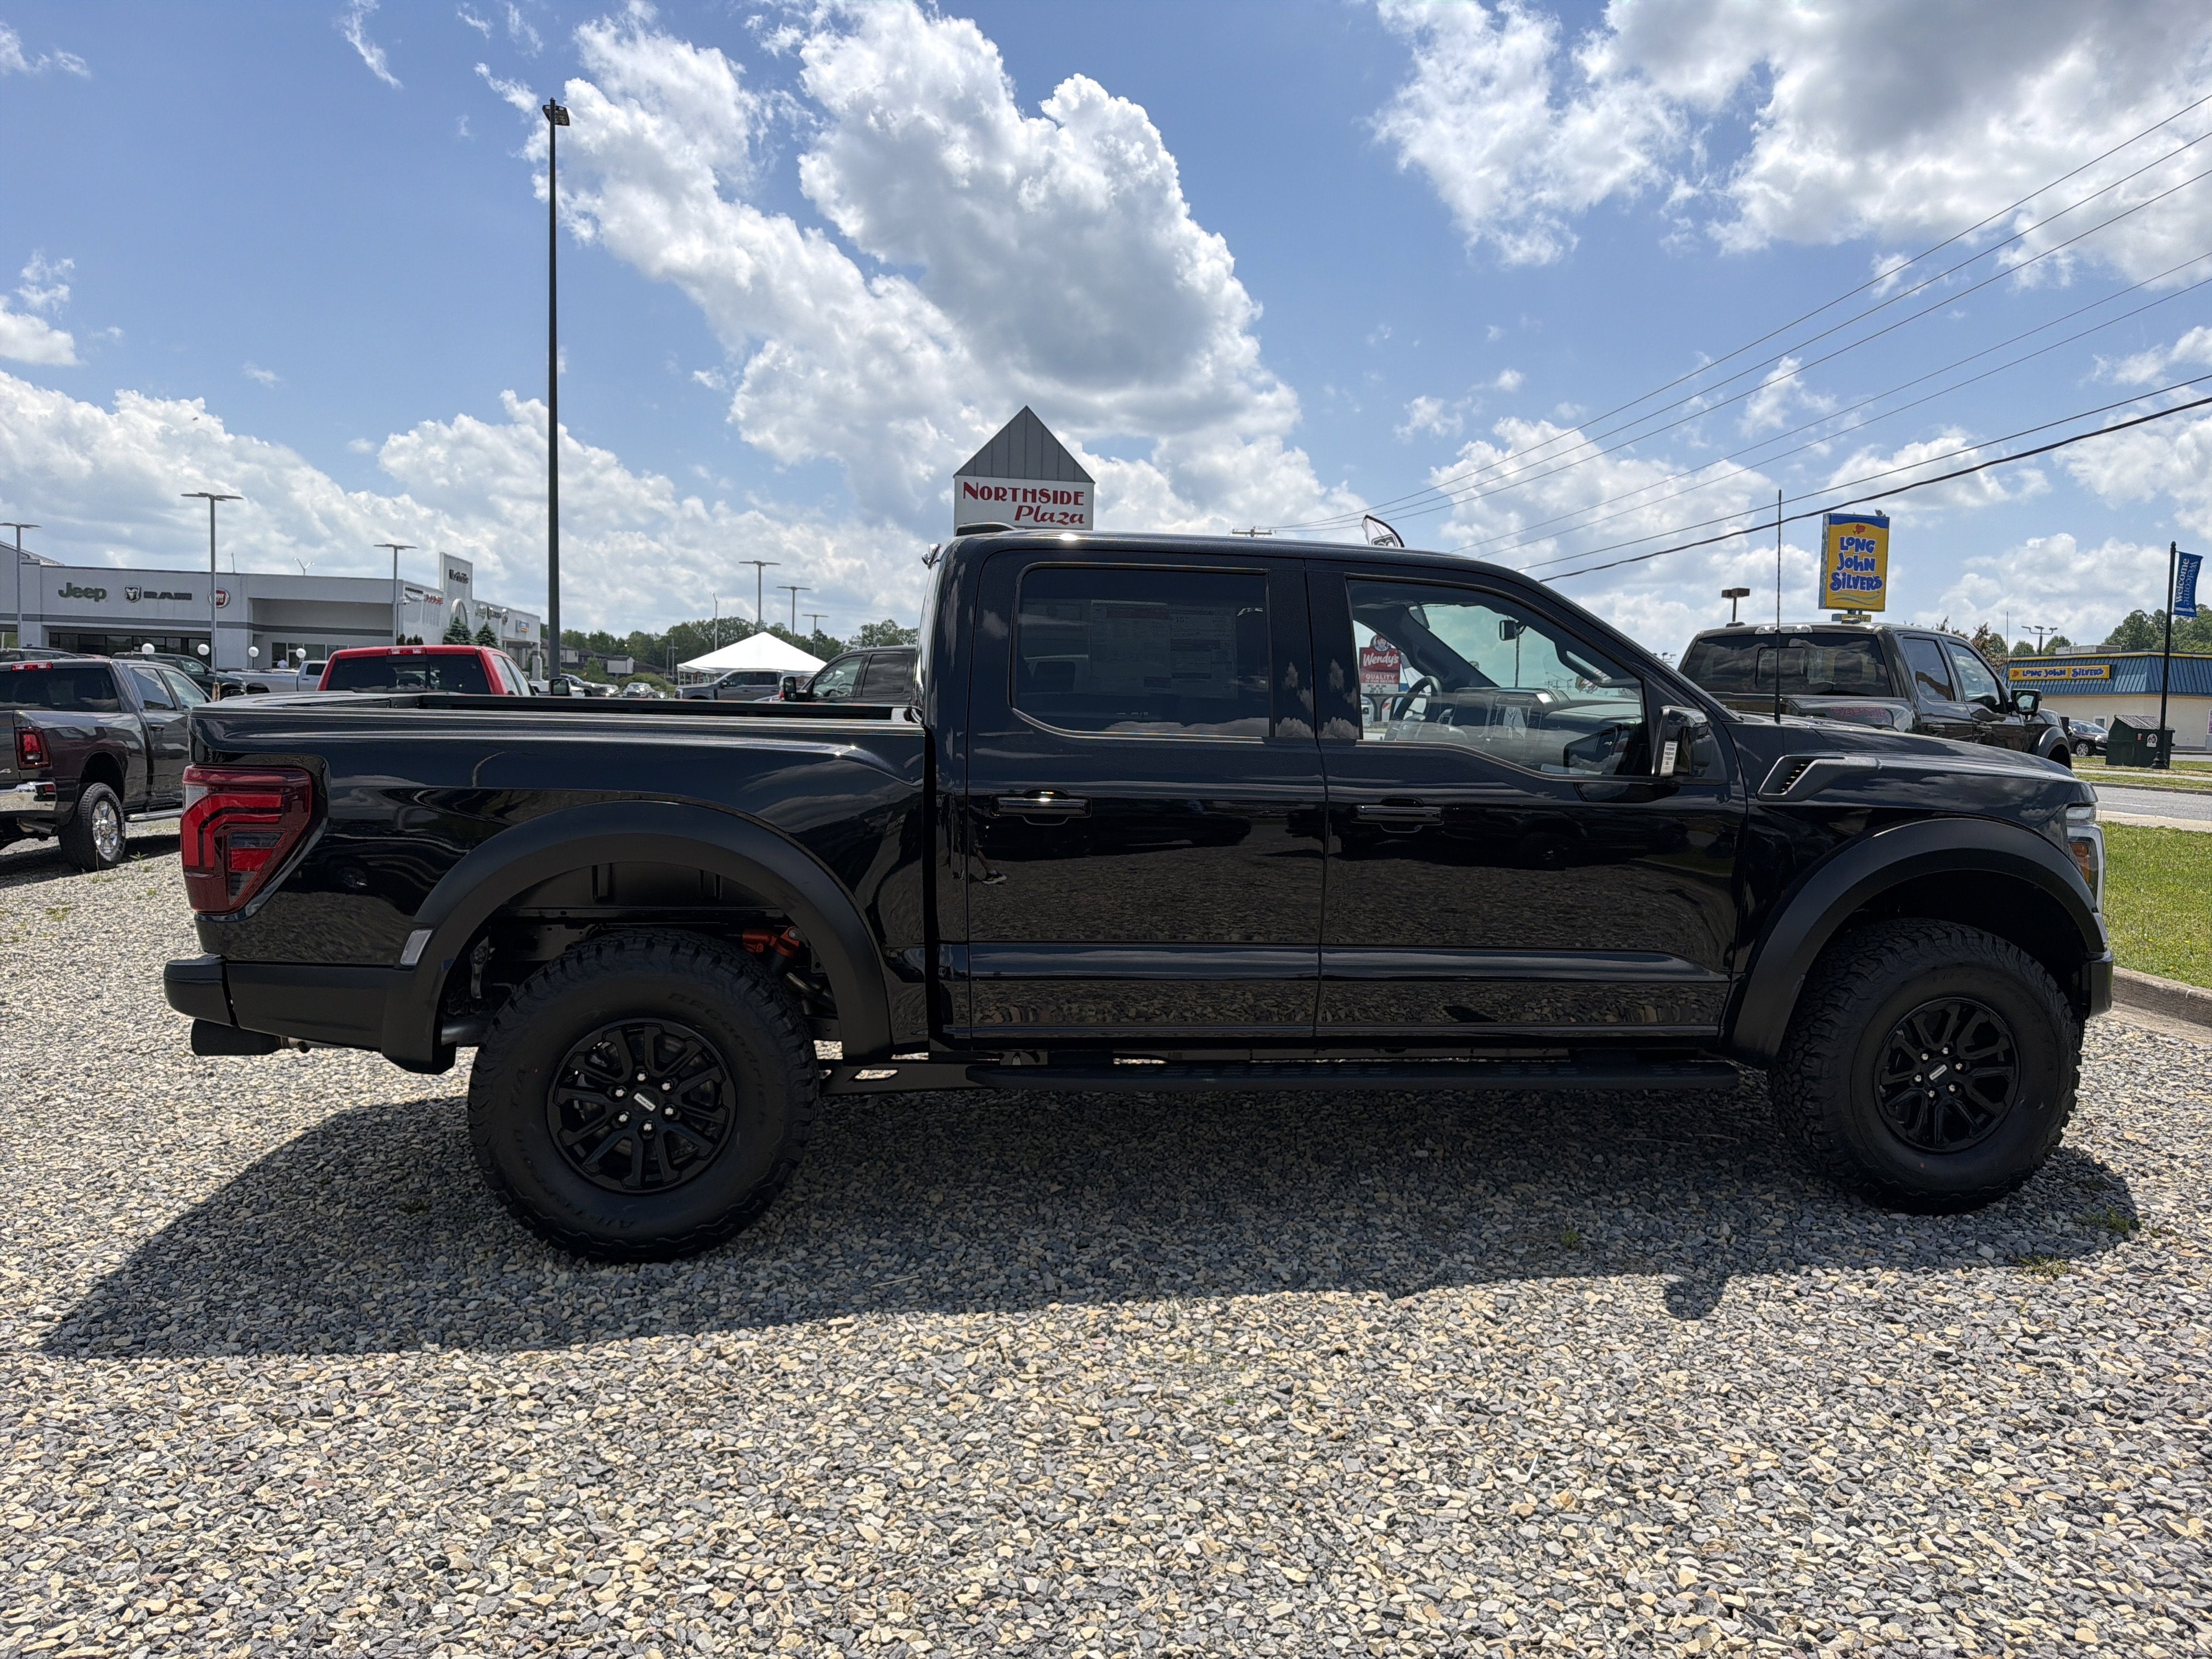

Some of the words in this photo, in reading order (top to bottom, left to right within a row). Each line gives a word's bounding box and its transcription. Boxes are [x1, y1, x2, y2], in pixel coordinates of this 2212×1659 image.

[963, 482, 1085, 506] NORTHSIDE
[1014, 505, 1085, 526] Plaza
[1839, 536, 1876, 554] LONG
[2175, 558, 2190, 603] Welcome
[2183, 561, 2198, 606] Welcome
[58, 582, 107, 602] Jeep
[143, 591, 192, 600] RAM
[1363, 652, 1400, 667] Wendy's
